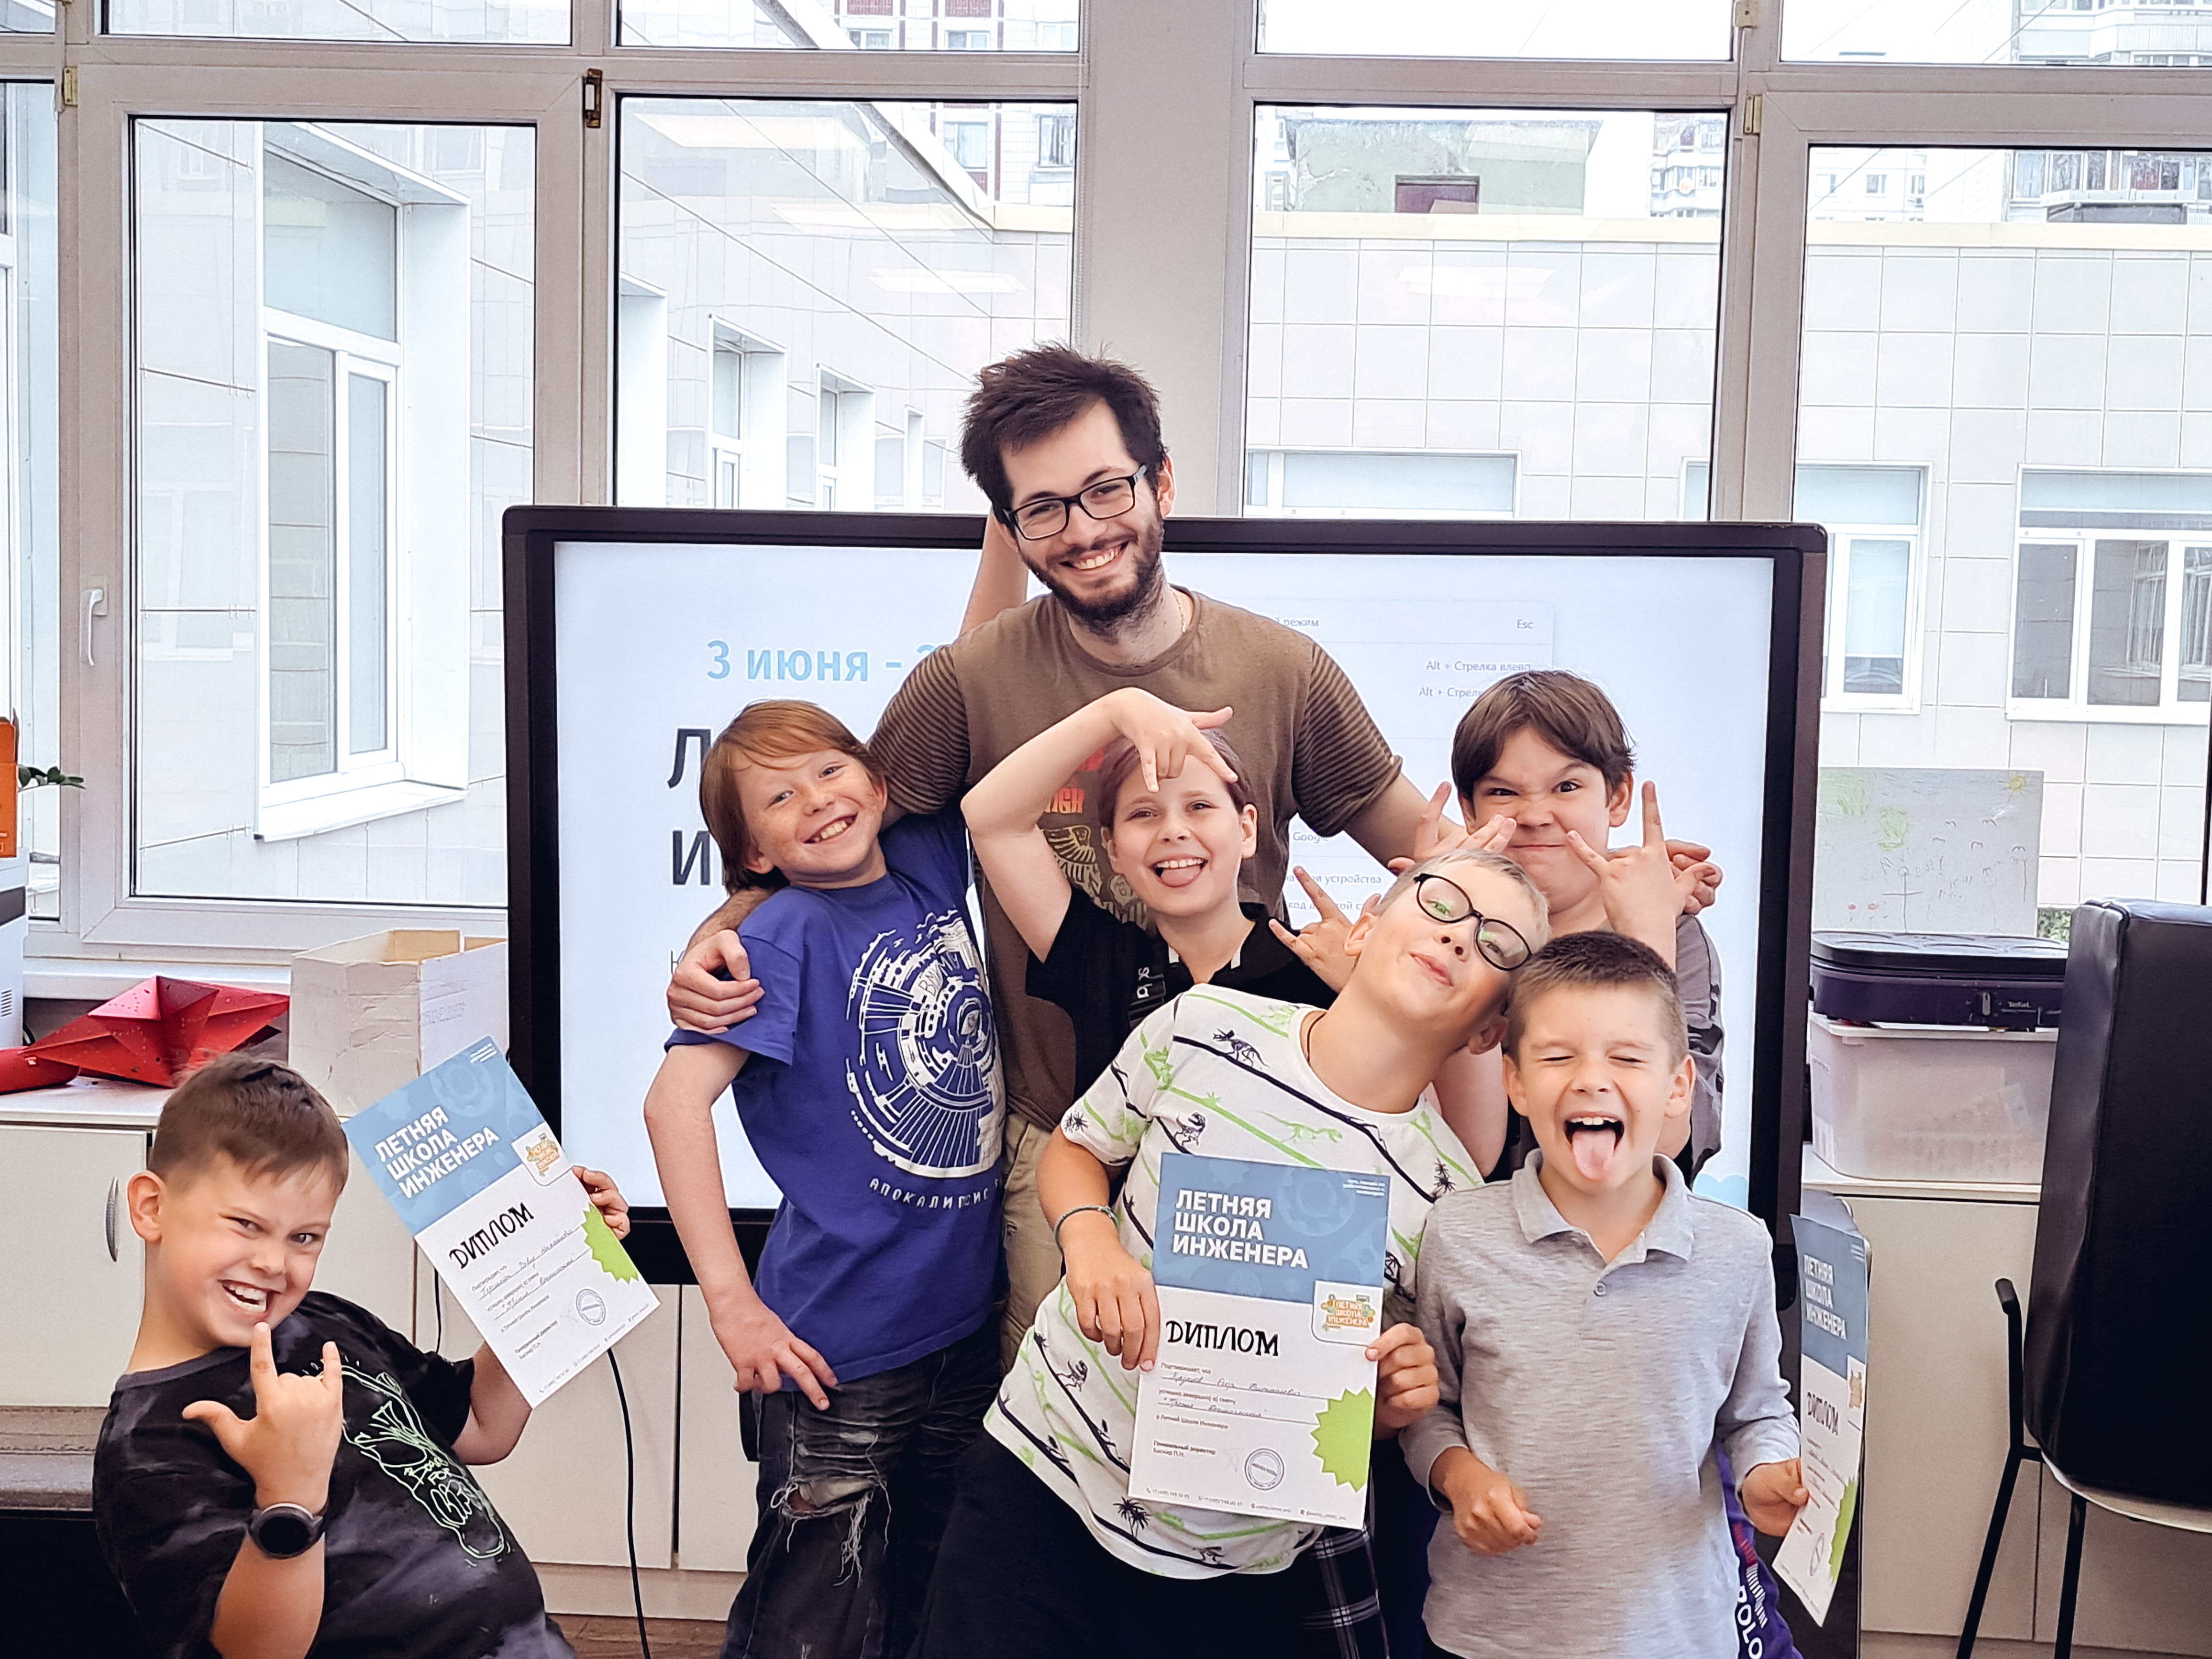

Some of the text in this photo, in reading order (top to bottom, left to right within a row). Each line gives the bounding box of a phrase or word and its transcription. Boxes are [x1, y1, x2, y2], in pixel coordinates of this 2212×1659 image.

[1516, 619, 1534, 629] Esc
[706, 640, 730, 680] 3
[747, 649, 868, 682] июня
[1426, 661, 1440, 671] Alt
[1454, 661, 1497, 673] Стрелка
[1418, 687, 1433, 697] Alt
[1447, 687, 1483, 699] Стрел
[1325, 874, 1382, 885] устройства
[374, 1106, 449, 1162] ЛЕТНЯЯ
[386, 1128, 458, 1181] ШКОЛА
[398, 1126, 500, 1198] ИНЖЕНЕРА
[1175, 1189, 1272, 1219] ЛЕТНЯЯ
[449, 1202, 534, 1269] ДИПЛОМ
[1174, 1211, 1264, 1241] ШКОЛА
[1172, 1234, 1309, 1270] ИНЖЕНЕРА
[1165, 1320, 1279, 1357] ДИПЛОМ
